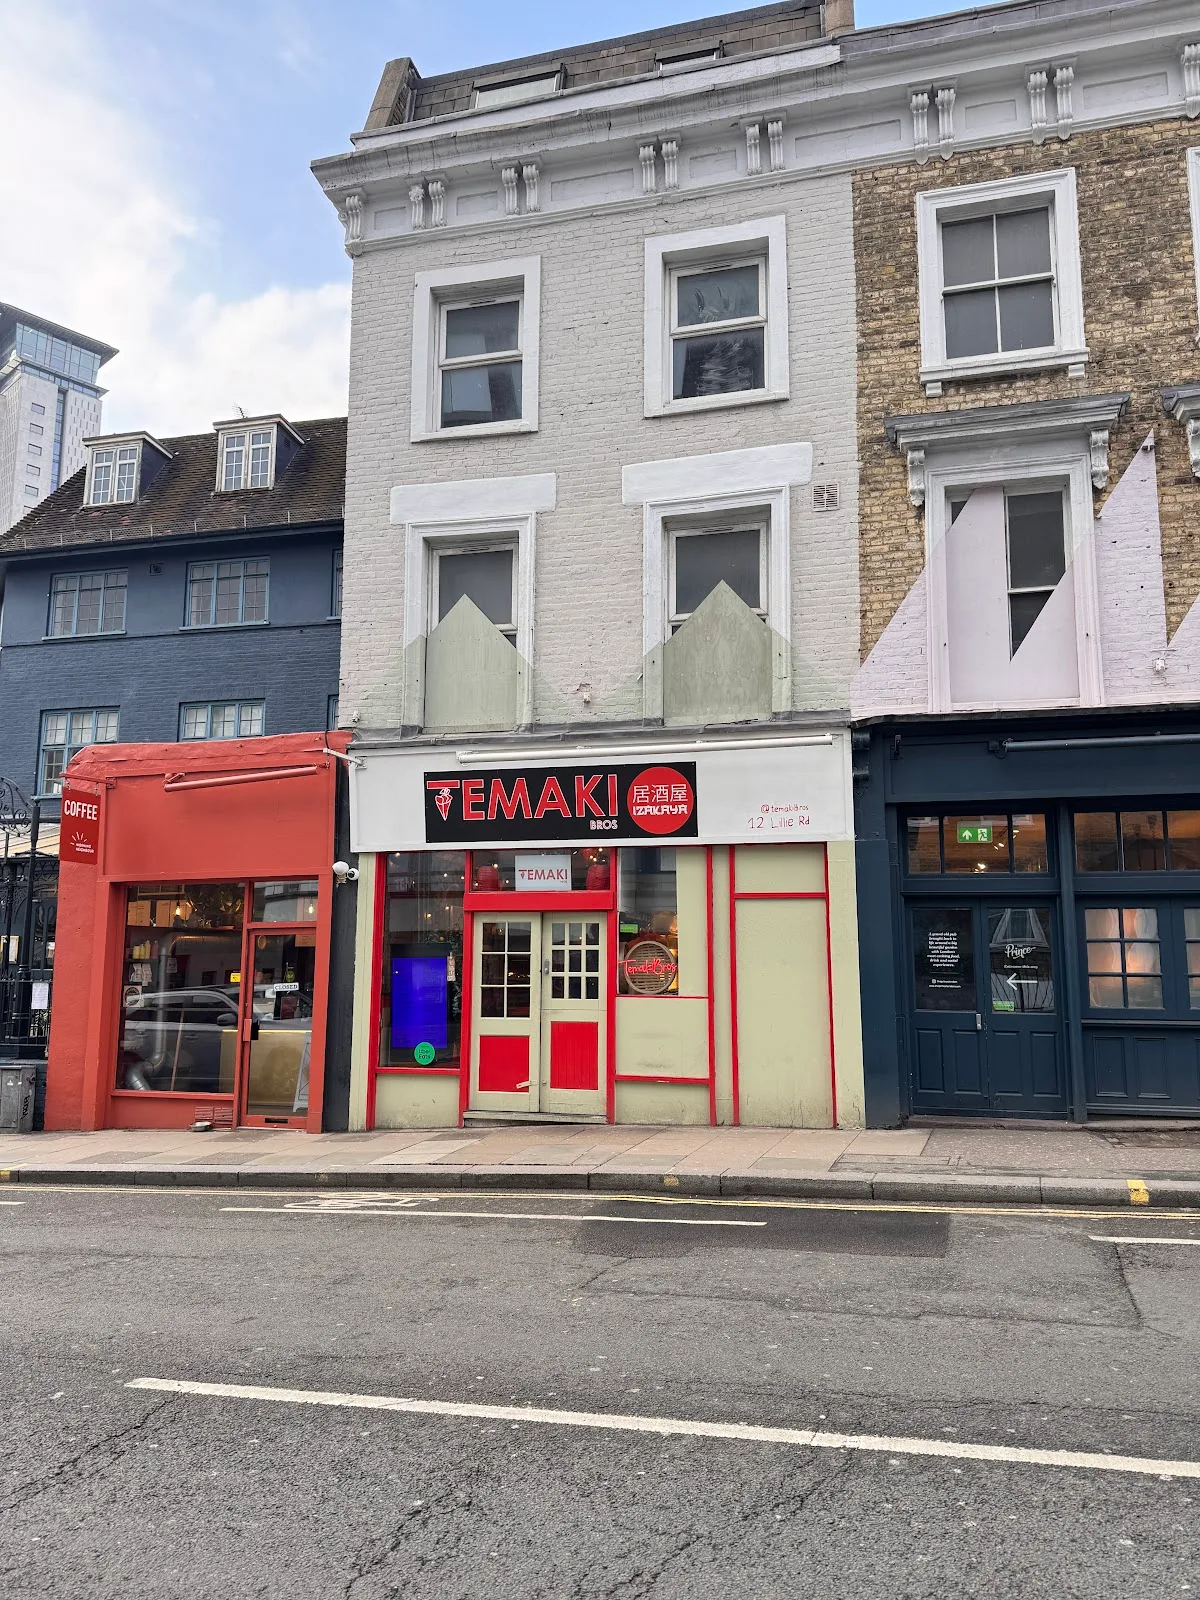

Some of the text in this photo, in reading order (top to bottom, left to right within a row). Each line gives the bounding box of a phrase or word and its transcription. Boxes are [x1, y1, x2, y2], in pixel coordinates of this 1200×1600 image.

[426, 774, 619, 821] TEMAKI
[632, 784, 688, 803] 居酒屋
[64, 799, 98, 820] COFFEE
[632, 804, 688, 815] IZAKAYA
[589, 819, 618, 830] BROS
[747, 815, 810, 829] 12 Lillie Rd
[518, 868, 568, 881] TEMAKI
[1005, 944, 1036, 959] Prince
[274, 983, 298, 991] CLOSED
